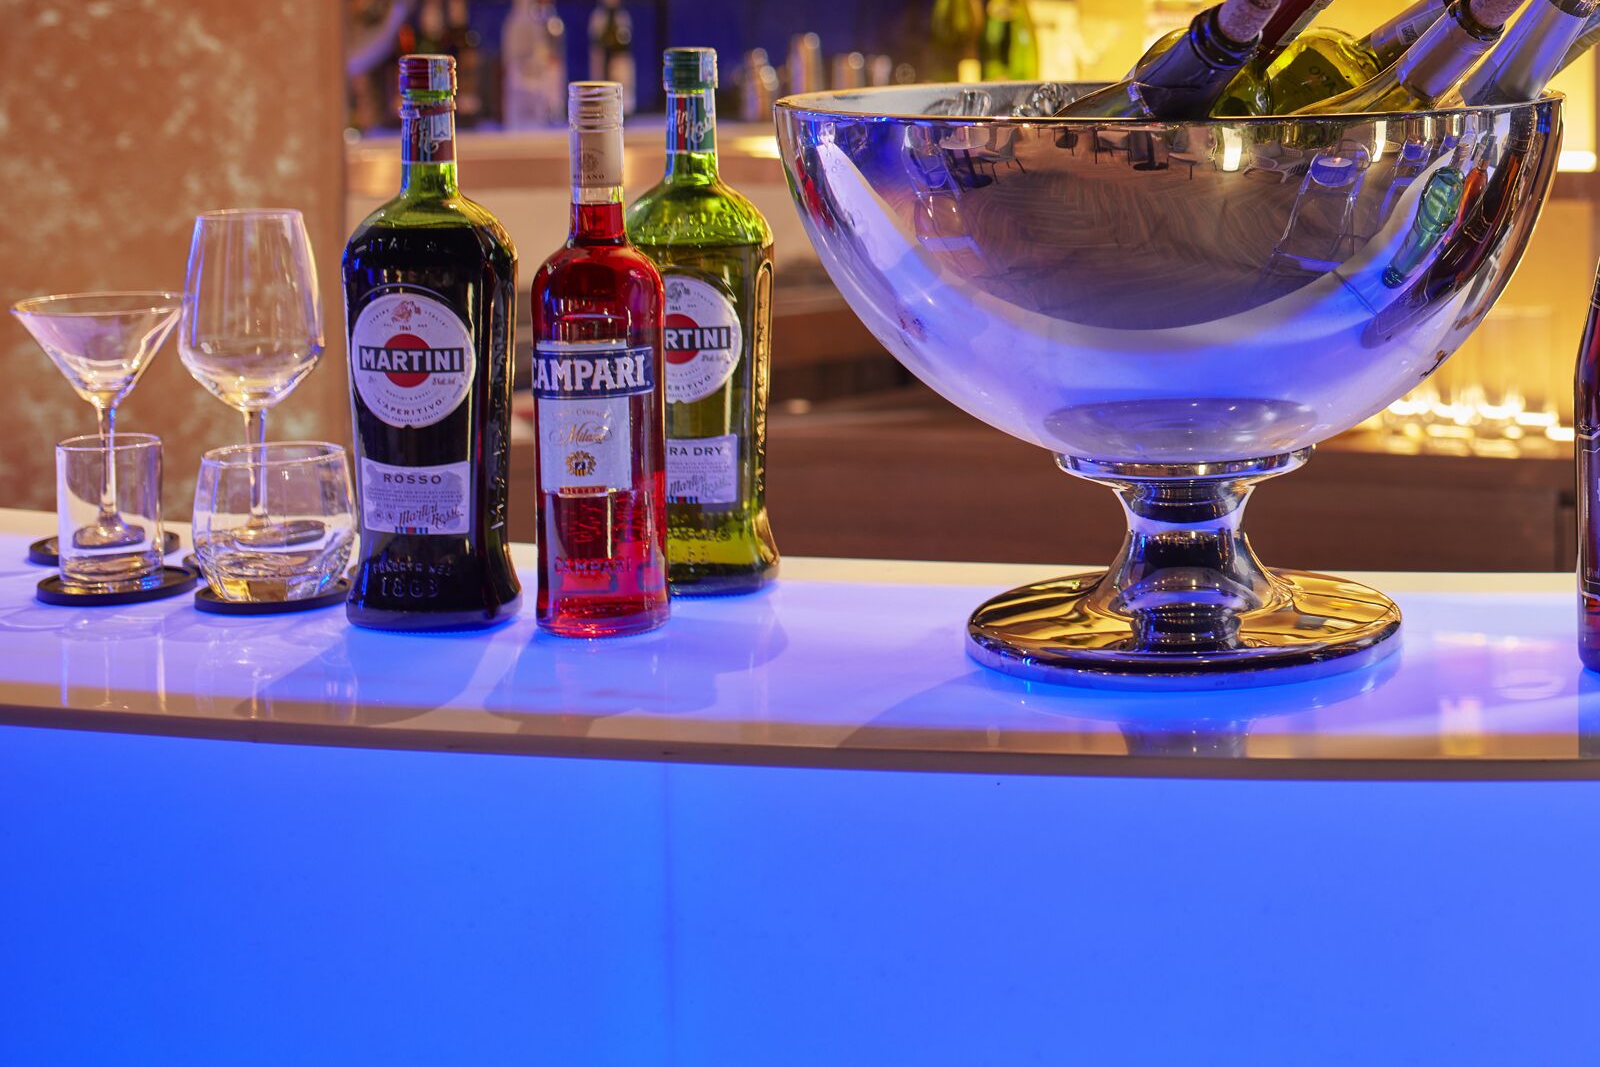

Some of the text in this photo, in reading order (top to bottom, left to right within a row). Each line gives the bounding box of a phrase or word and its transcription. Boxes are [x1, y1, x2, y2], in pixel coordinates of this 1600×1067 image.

[665, 329, 728, 349] RTINI
[361, 348, 461, 372] MARTINI
[667, 375, 711, 391] ERITIVO
[376, 398, 443, 416] L'APERITIVO
[694, 446, 724, 455] DRY
[384, 474, 442, 484] ROSSO
